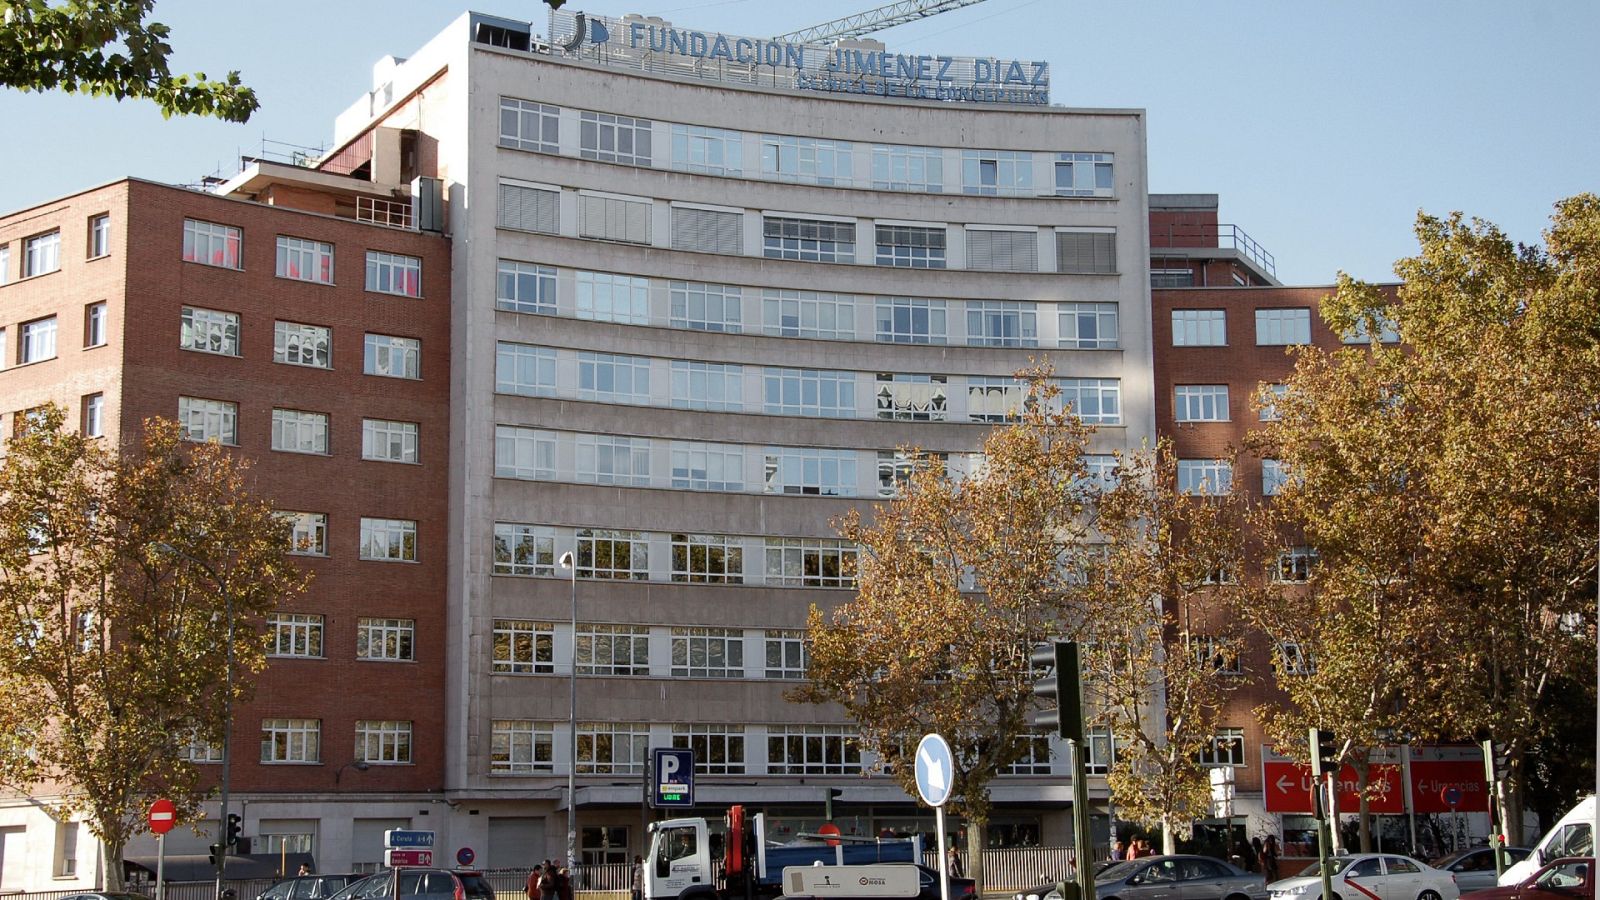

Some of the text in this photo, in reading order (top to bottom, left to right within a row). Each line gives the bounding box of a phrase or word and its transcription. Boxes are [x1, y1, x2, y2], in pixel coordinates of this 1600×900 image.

[630, 22, 1048, 86] FUNDACION JIMENEZ DIAZ
[662, 755, 680, 783] P
